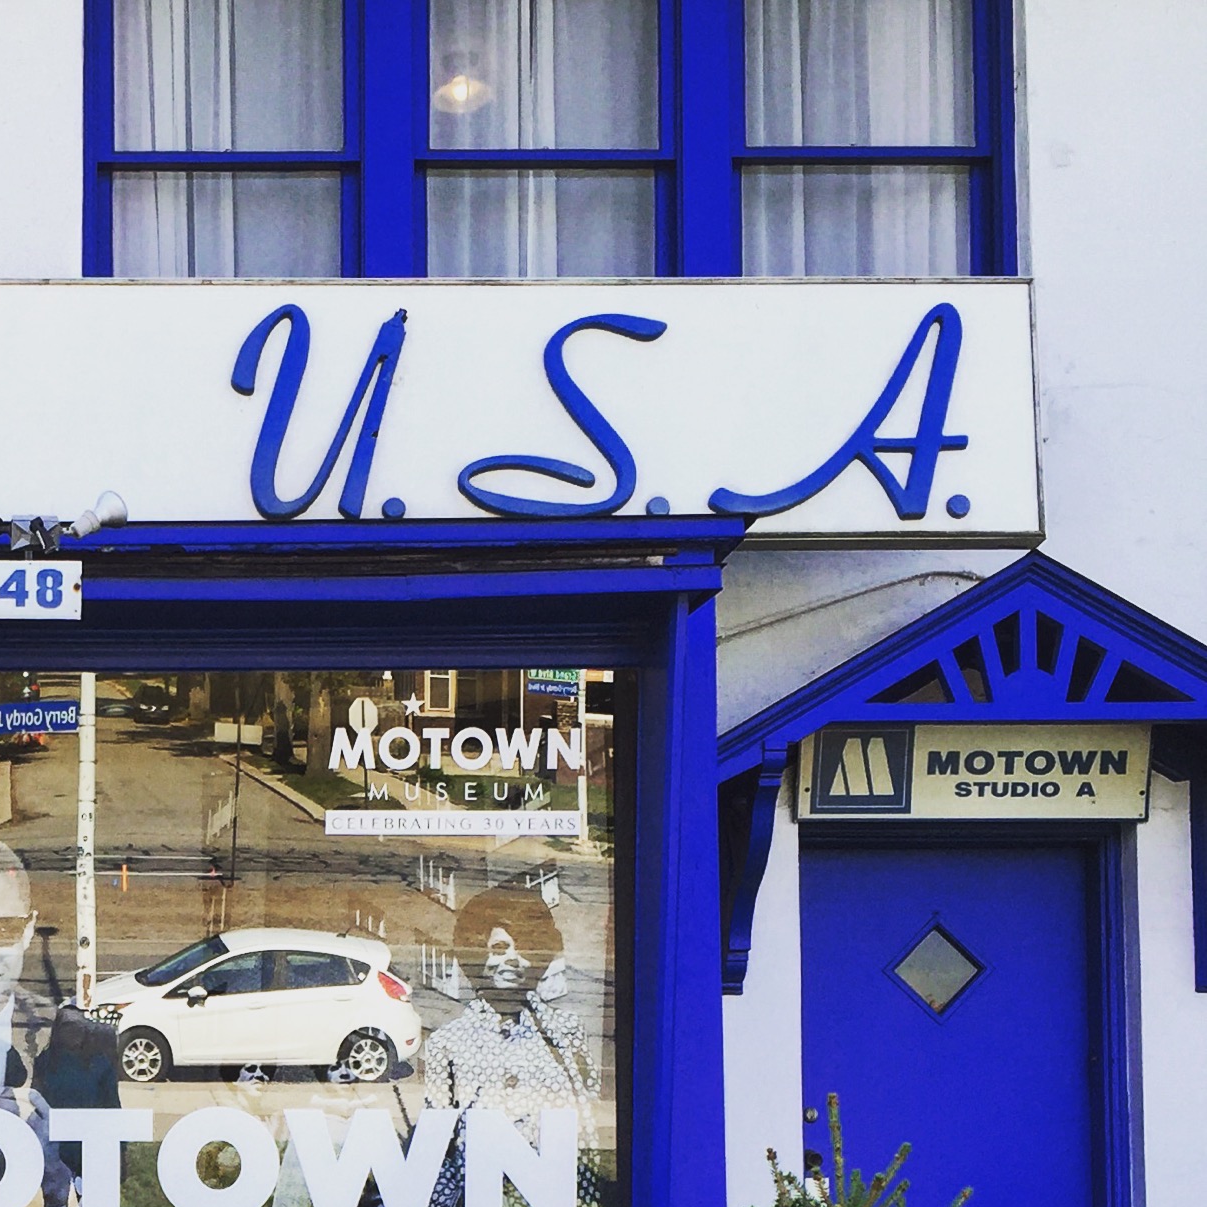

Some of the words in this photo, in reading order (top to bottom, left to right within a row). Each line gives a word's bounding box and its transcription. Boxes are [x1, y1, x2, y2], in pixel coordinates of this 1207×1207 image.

[328, 727, 581, 770] MOTOWN
[926, 750, 1129, 776] MOTOWN
[368, 782, 544, 801] MUSEUM
[954, 782, 1061, 798] STUDIO
[1076, 782, 1096, 797] A
[331, 817, 472, 831] CELEBRATING
[483, 817, 504, 831] 30
[514, 817, 577, 831] YEARS
